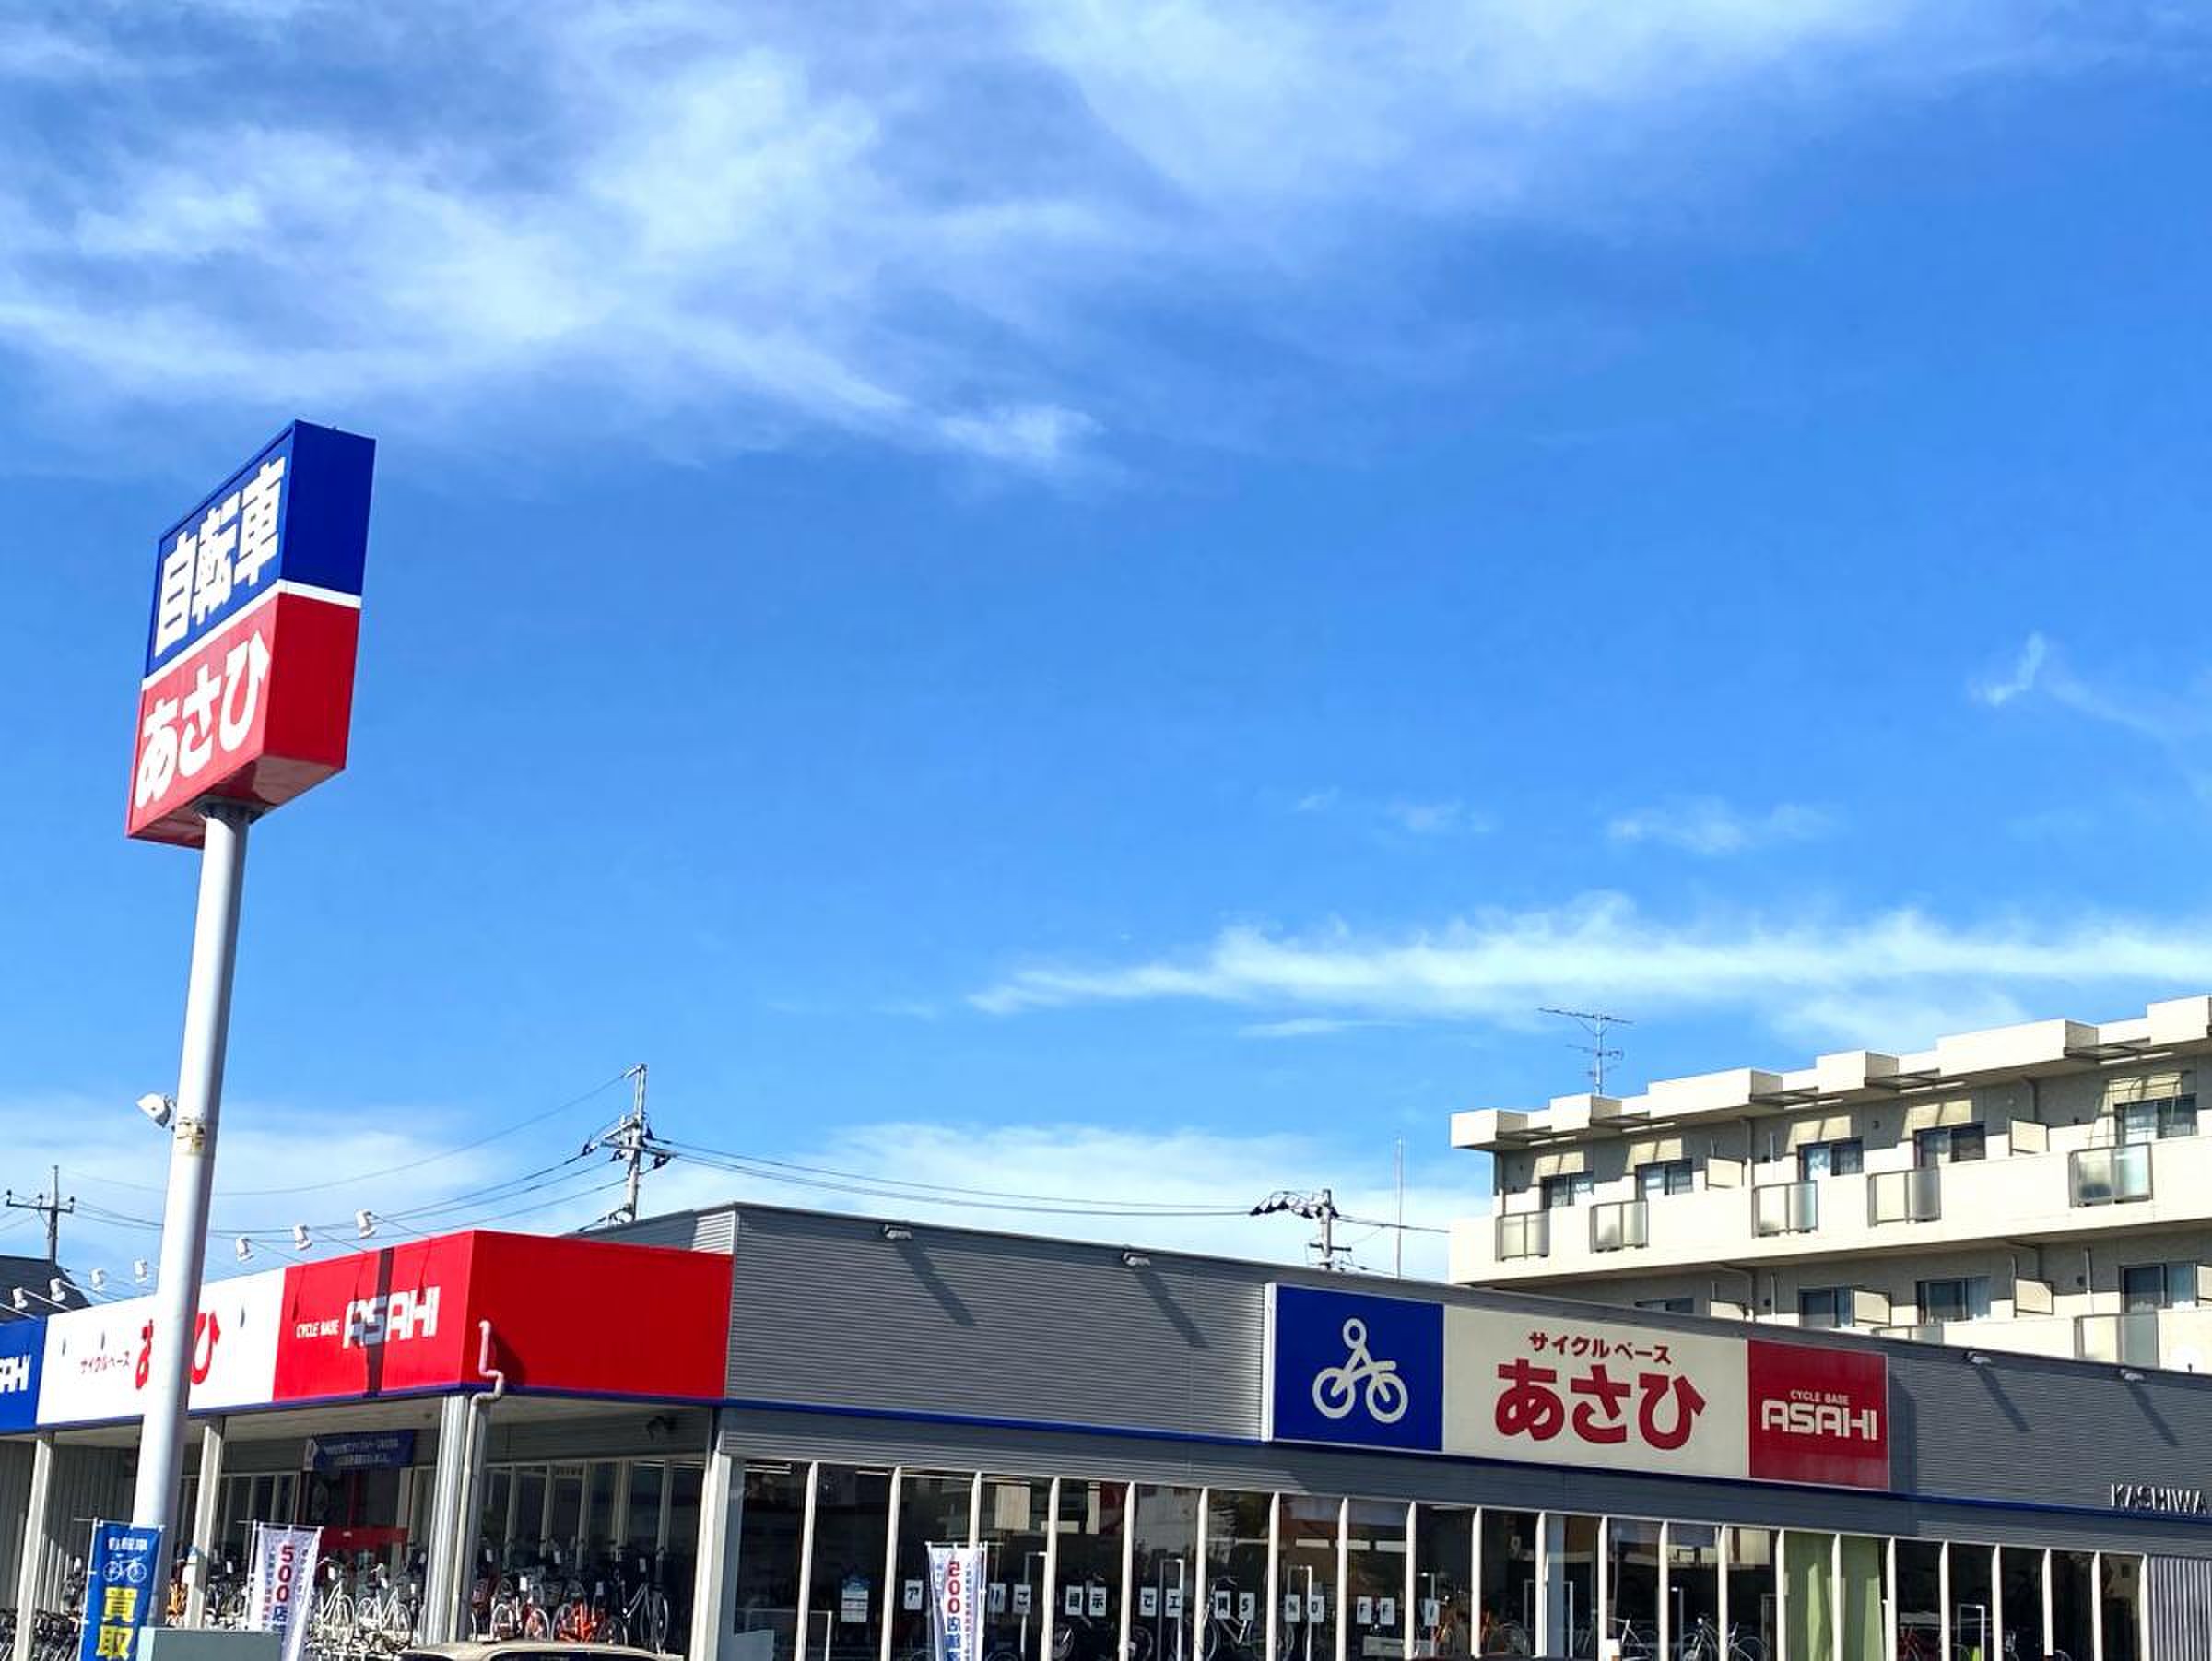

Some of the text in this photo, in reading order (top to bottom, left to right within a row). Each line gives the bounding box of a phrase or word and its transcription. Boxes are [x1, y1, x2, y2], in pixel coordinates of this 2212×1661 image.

[155, 457, 286, 657] 自転車
[135, 631, 270, 808] あさひ
[342, 1286, 440, 1349] ASAHI
[0, 1355, 30, 1394] AHI
[1529, 1332, 1672, 1365] サイクルベース
[1495, 1358, 1706, 1450] あさひ
[1761, 1400, 1877, 1441] ASAHI
[1790, 1389, 1850, 1406] CYCLE BASE
[2111, 1483, 2207, 1514] KASHIWA
[96, 1586, 138, 1660] 買取
